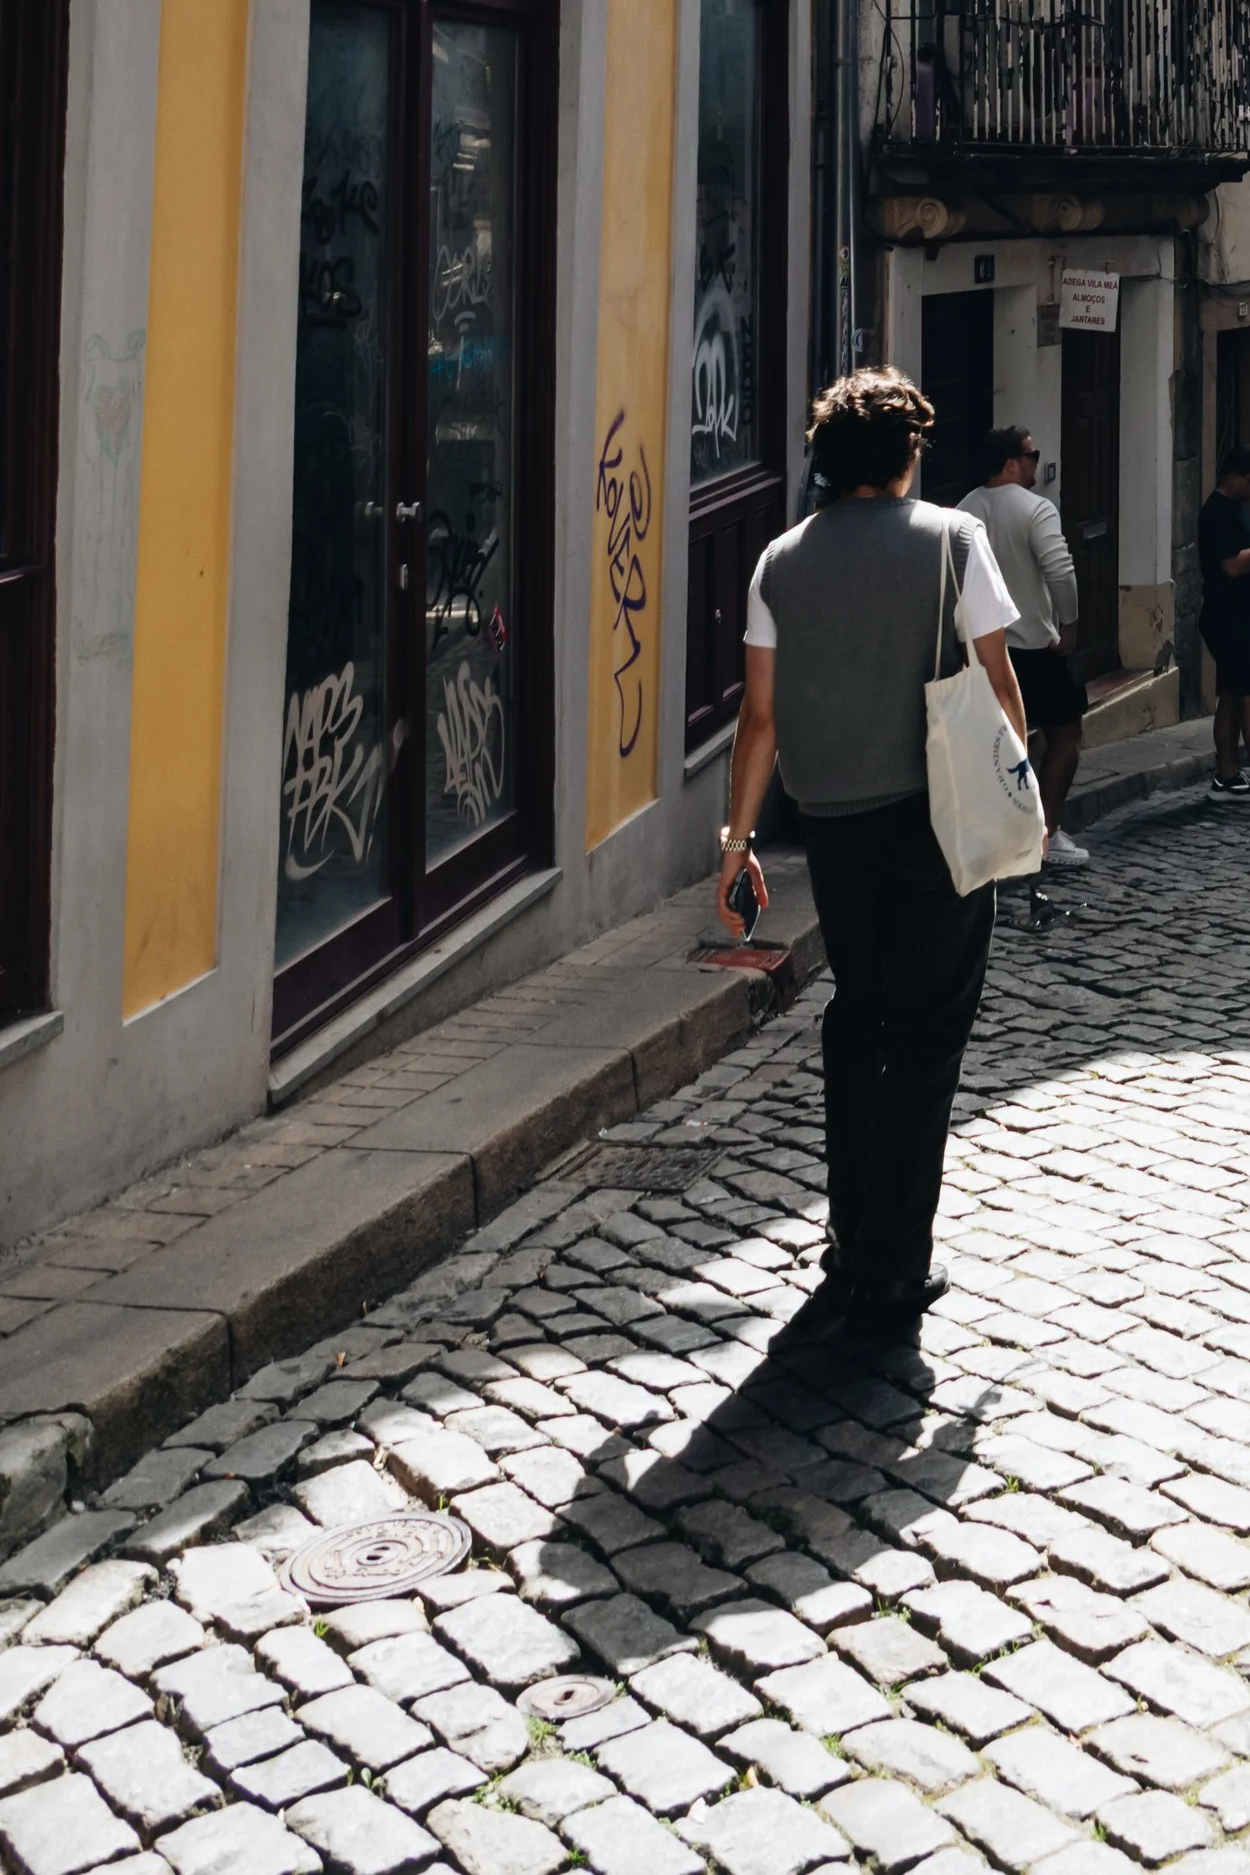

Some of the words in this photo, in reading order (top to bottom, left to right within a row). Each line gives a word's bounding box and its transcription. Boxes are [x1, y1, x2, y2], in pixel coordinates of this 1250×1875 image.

[1062, 277, 1086, 287] ADEGA
[1087, 279, 1103, 288] VILA
[1072, 293, 1106, 304] ALMOÇOS
[1085, 305, 1091, 314] E
[1071, 315, 1106, 326] JANTARES
